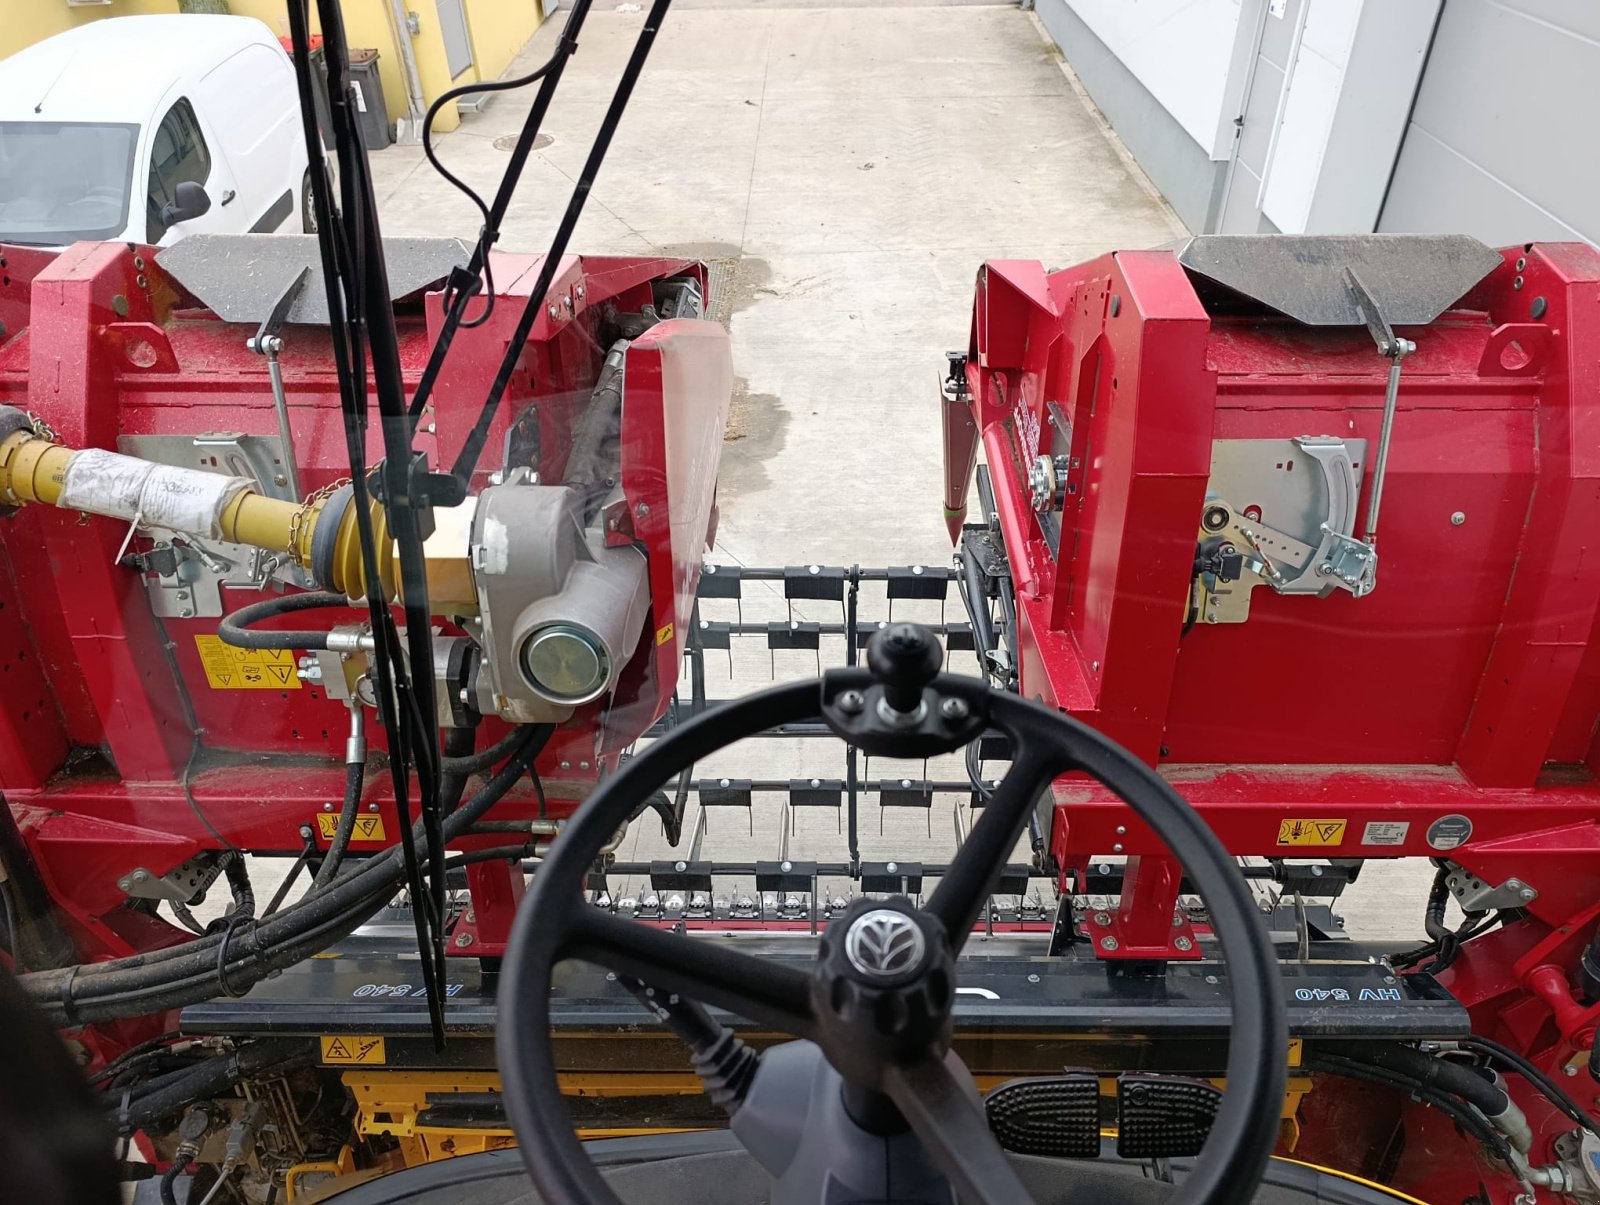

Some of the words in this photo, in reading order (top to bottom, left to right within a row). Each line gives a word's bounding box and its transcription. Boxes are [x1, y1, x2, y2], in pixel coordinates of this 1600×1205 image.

[353, 984, 412, 997] 540
[1295, 988, 1350, 1001] 540
[1358, 988, 1401, 1001] HV
